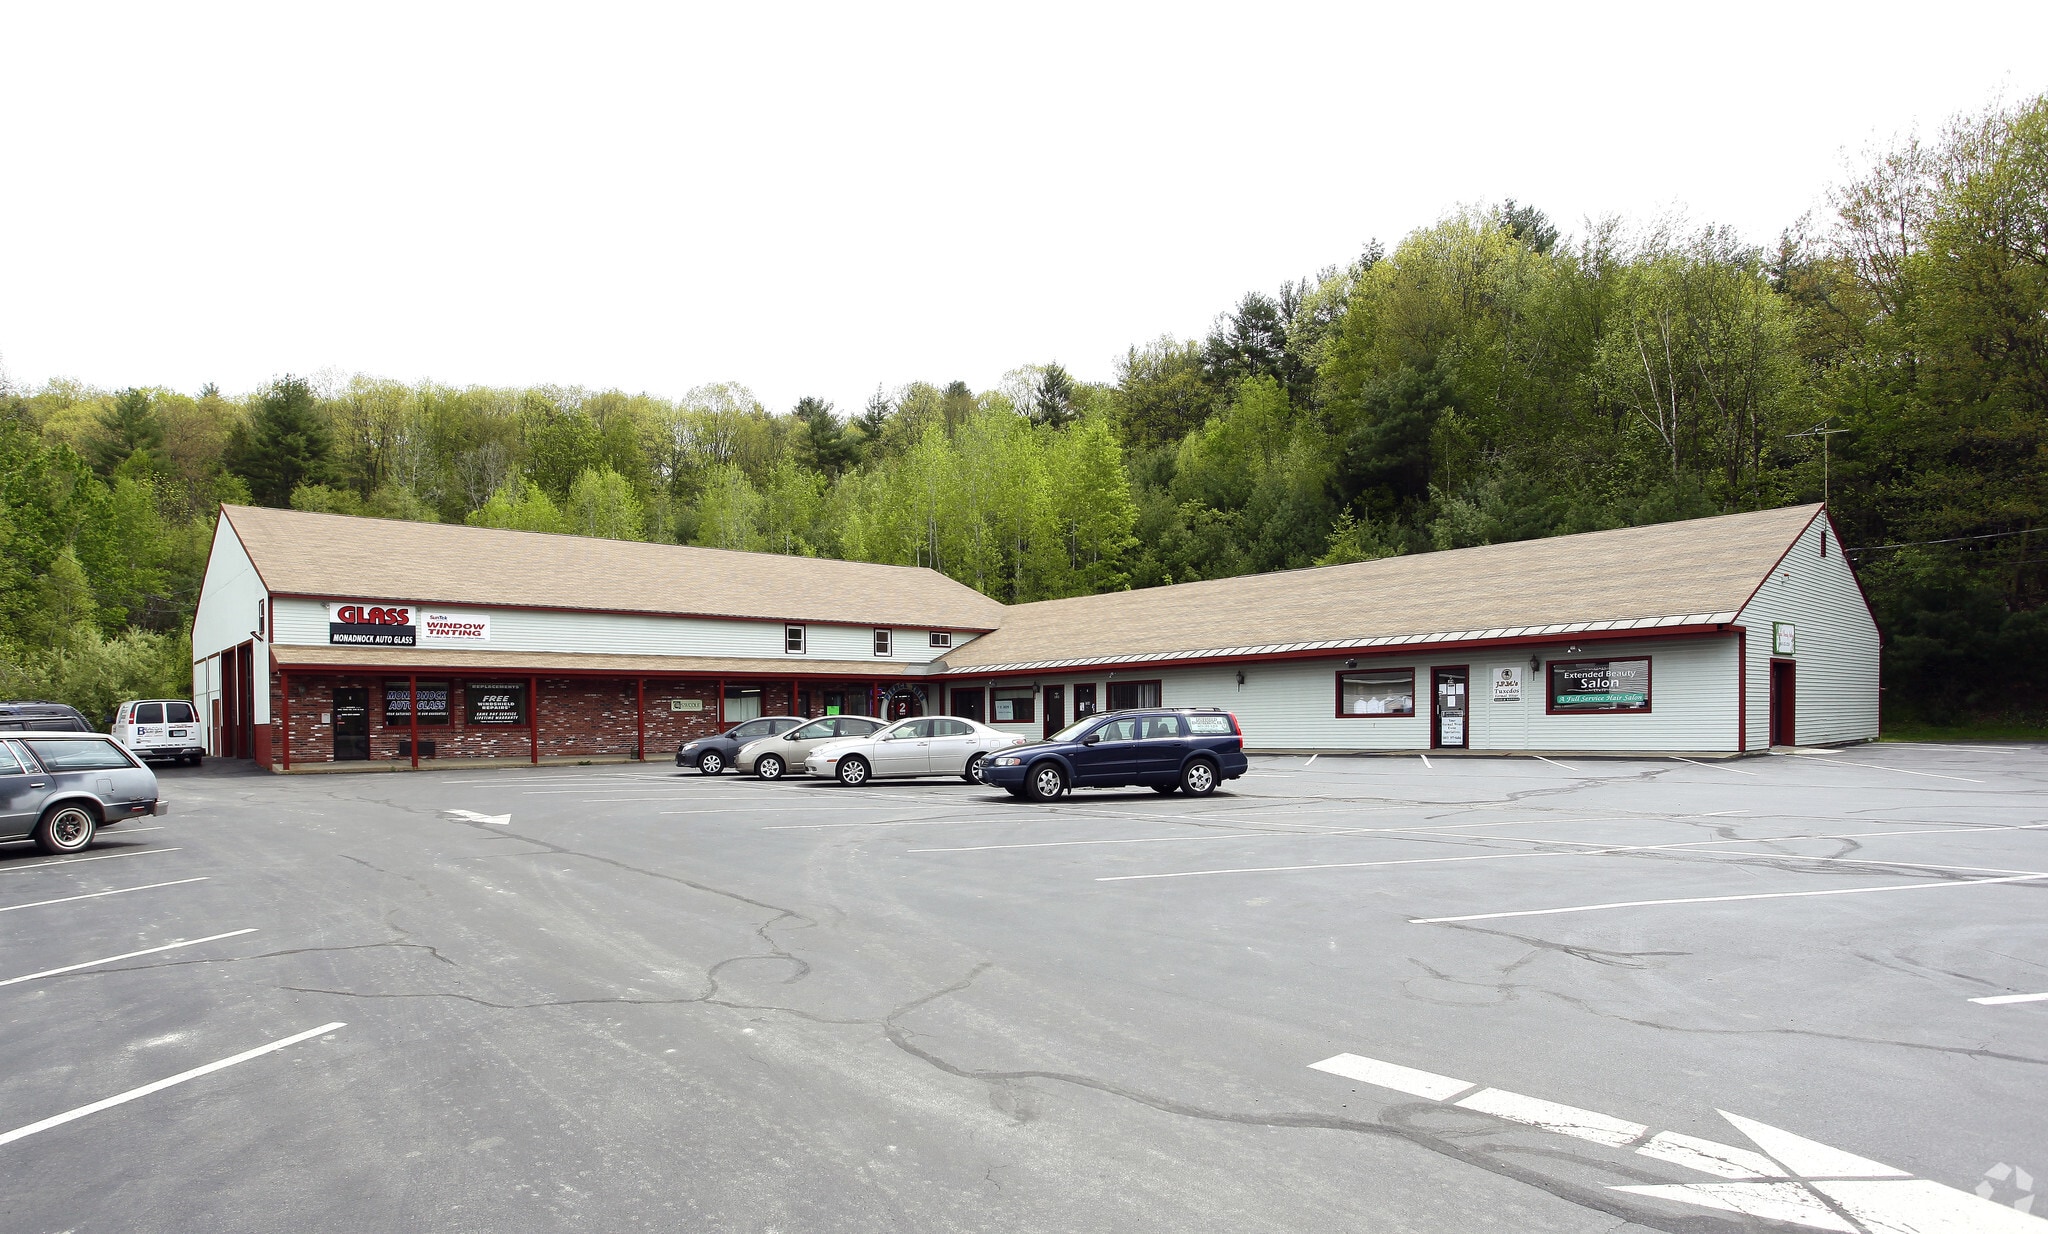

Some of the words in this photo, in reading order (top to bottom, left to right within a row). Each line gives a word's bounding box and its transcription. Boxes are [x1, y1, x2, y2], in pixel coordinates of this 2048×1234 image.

[337, 605, 410, 626] GLASS
[427, 622, 485, 630] WINDOW
[333, 633, 374, 644] MONADNOCK
[375, 635, 392, 644] AUTO
[393, 635, 413, 644] GLASS
[1564, 671, 1604, 679] Extended
[1606, 670, 1636, 678] Beauty
[1580, 678, 1620, 689] Salon
[386, 691, 447, 700] MONDNOCK
[1566, 695, 1580, 703] Full
[1605, 694, 1622, 702] Hair
[1622, 693, 1643, 701] Salon
[416, 700, 446, 710] GLASS
[899, 702, 906, 713] 2
